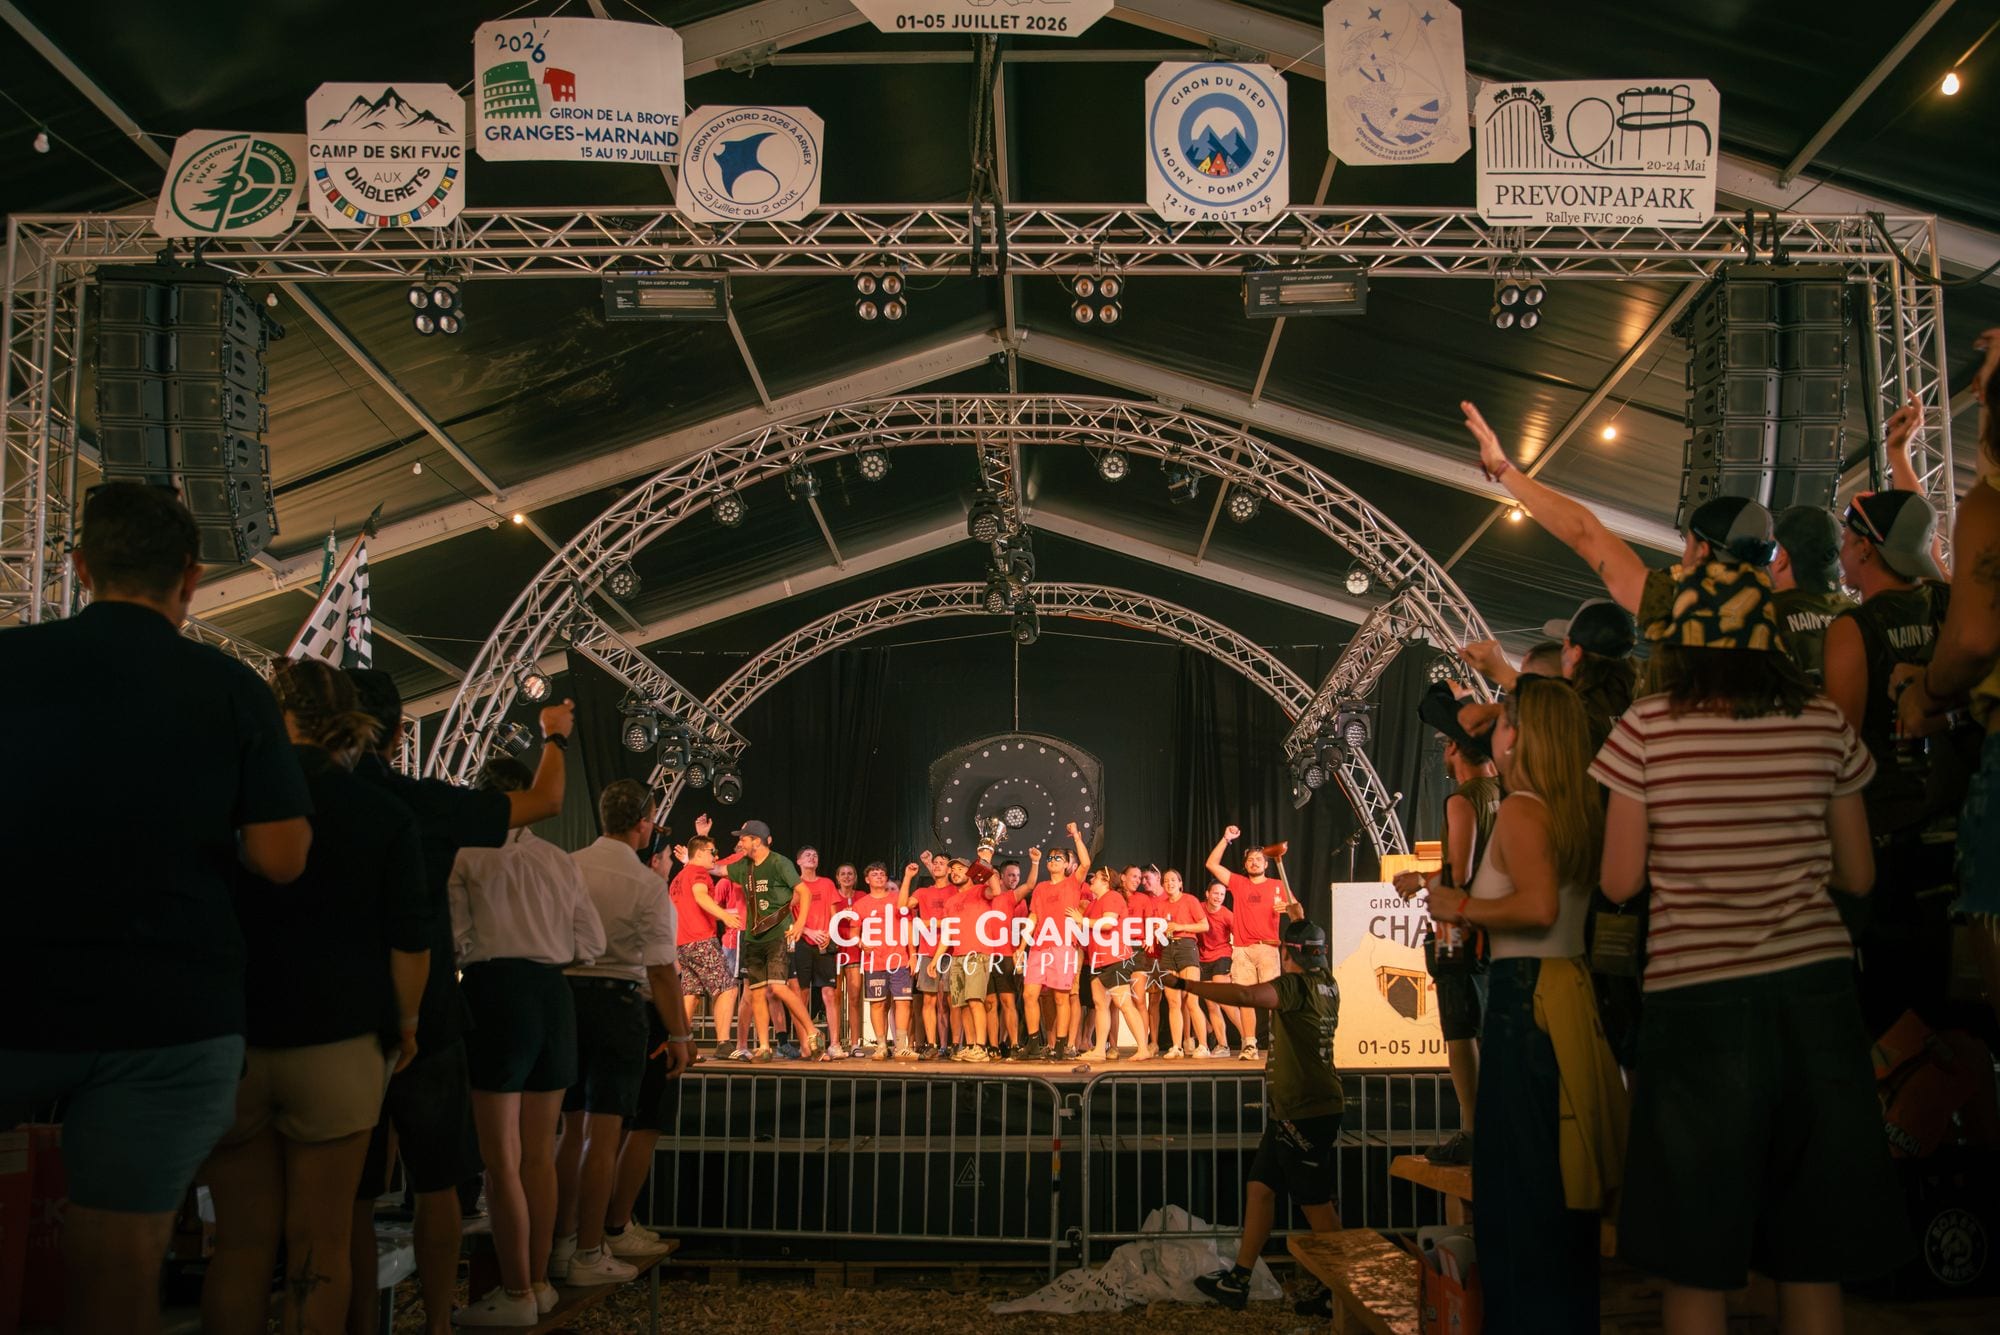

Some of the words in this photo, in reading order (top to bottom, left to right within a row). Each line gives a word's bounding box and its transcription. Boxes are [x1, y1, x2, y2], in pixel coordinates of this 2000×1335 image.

[896, 14, 945, 29] 01-05
[952, 14, 1020, 29] JUILLET
[1026, 16, 1068, 31] 2026
[494, 31, 546, 63] 2026
[1171, 77, 1209, 105] GIRON
[1215, 76, 1233, 86] DU
[1238, 83, 1266, 109] PIED
[550, 107, 593, 120] GIRON
[597, 109, 613, 121] DE
[617, 110, 633, 122] LA
[637, 112, 679, 126] BROYE
[485, 125, 679, 147] GRANGES-MARNAND
[691, 131, 713, 162] GIRON
[709, 120, 726, 133] DU
[726, 113, 760, 125] NORD
[760, 113, 790, 129] 2026
[795, 133, 812, 165] ARNEX
[309, 144, 358, 158] CAMP
[363, 145, 385, 158] DE
[390, 145, 416, 158] SKI
[421, 145, 461, 159] FVJC
[580, 147, 592, 158] 15
[595, 148, 612, 159] AU
[616, 149, 627, 160] 19
[630, 149, 679, 163] JUILLET
[183, 171, 195, 184] Tir
[191, 141, 238, 170] Cantonal
[1161, 147, 1194, 186] MOIRY
[1208, 149, 1275, 195] POMPAPLES
[1645, 160, 1680, 172] 20-24
[1683, 159, 1706, 172] Mai
[196, 163, 218, 184] FVJC
[344, 165, 431, 203] DIABLERETS
[373, 171, 402, 184] AUX
[698, 188, 713, 202] 29
[709, 198, 742, 216] juillet
[743, 206, 760, 216] au
[762, 204, 770, 214] 2
[771, 188, 799, 210] août
[1165, 193, 1197, 216] 12-16
[1201, 209, 1237, 221] AOÛT
[1243, 195, 1273, 216] 2026
[1494, 184, 1696, 209] PREVONPAPARK
[1545, 211, 1580, 226] Rallye
[1583, 212, 1613, 224] FVJC
[1615, 214, 1644, 225] 2026
[1369, 898, 1411, 909] GIRON
[874, 986, 882, 997] 13
[1358, 1040, 1411, 1055] 01-05
